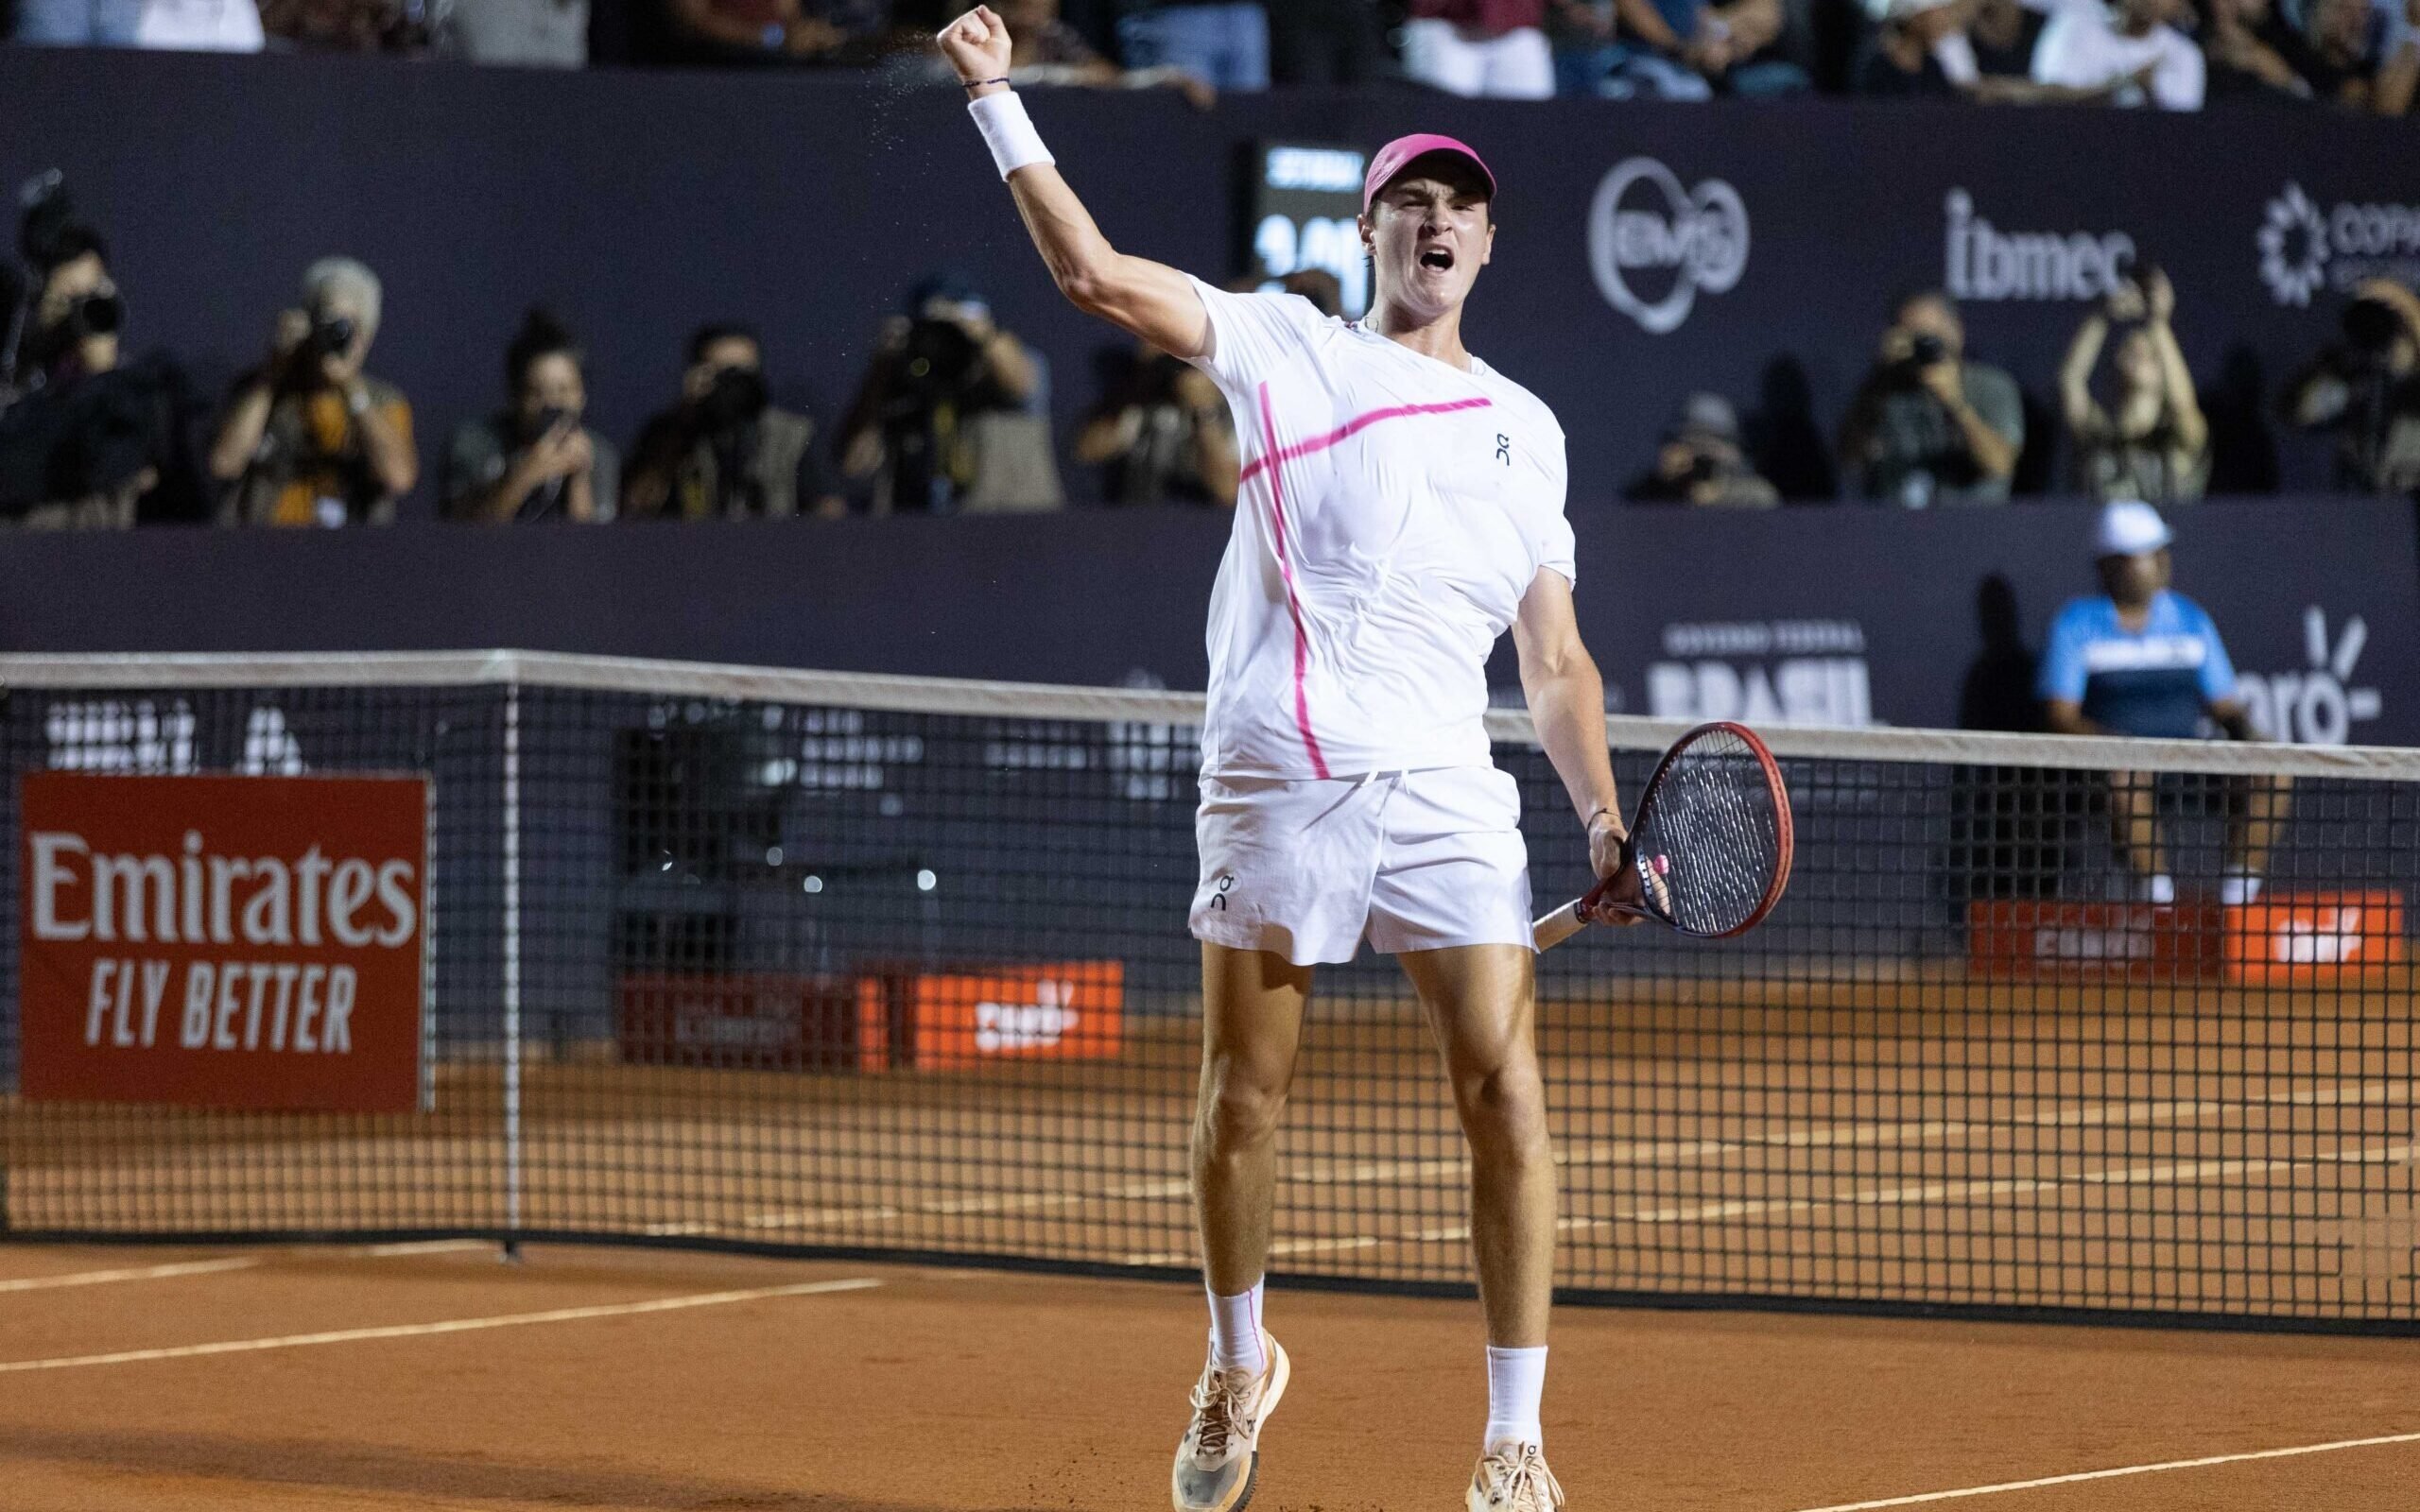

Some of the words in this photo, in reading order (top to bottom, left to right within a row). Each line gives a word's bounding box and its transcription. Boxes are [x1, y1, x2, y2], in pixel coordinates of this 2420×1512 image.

[31, 829, 416, 948] Emirates
[87, 958, 170, 1047] FLY
[180, 960, 356, 1054] BETTER
